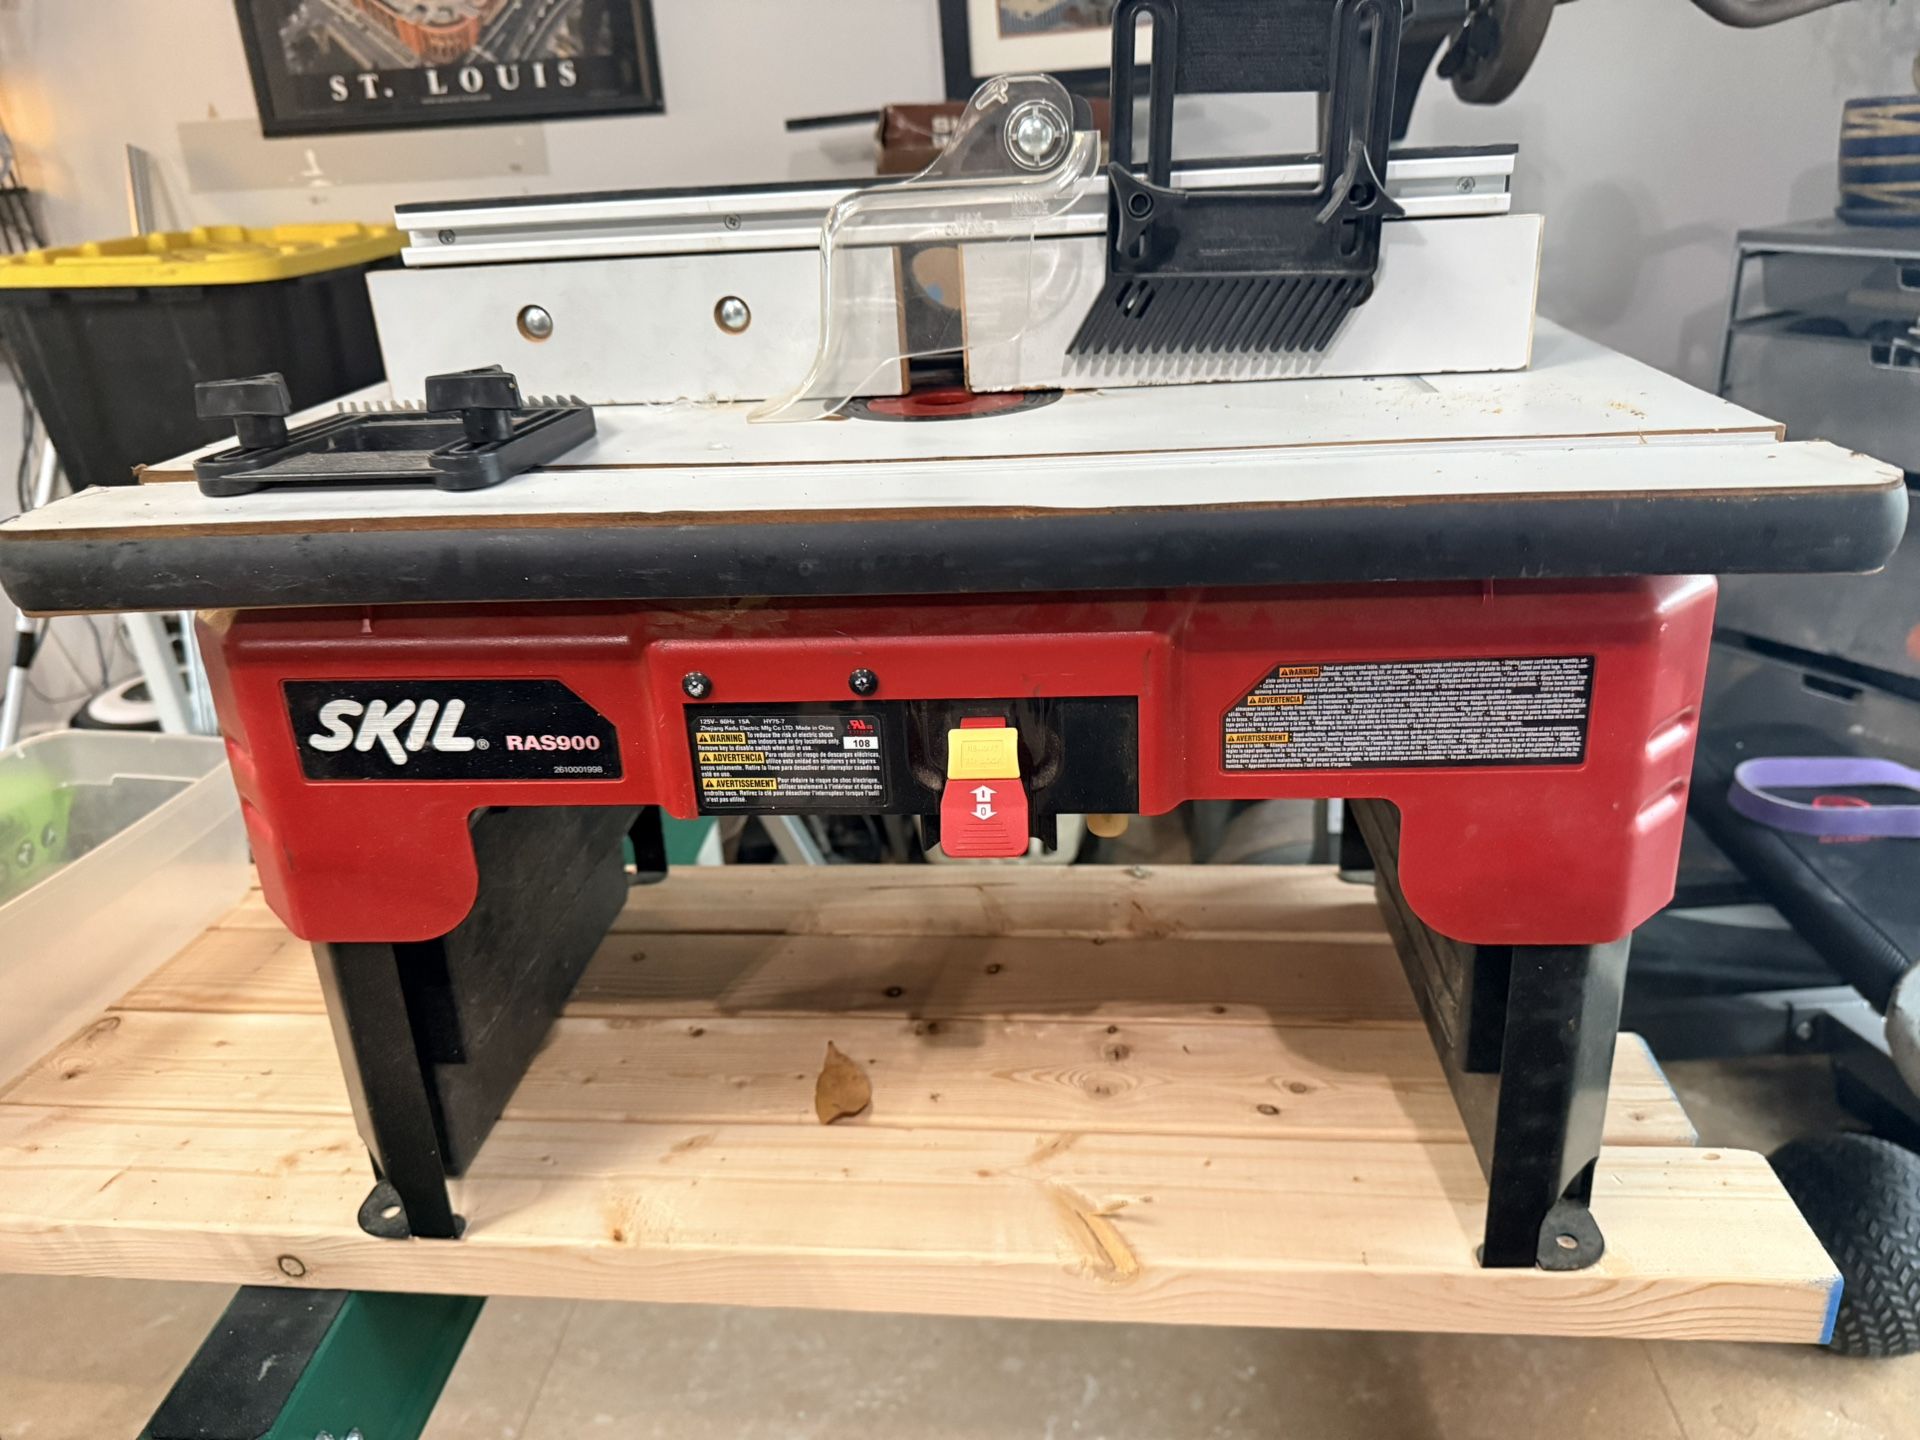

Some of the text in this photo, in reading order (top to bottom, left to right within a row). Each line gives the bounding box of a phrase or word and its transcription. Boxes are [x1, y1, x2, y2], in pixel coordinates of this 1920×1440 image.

[328, 61, 578, 103] ST. LOUIS
[1289, 668, 1318, 676] WARNING
[1257, 696, 1301, 704] ADVERTENCIA
[308, 698, 476, 766] SKIL
[708, 734, 743, 743] WARNING
[1236, 734, 1287, 742] AVERTISSEMENT
[506, 735, 601, 752] RAS900
[853, 739, 870, 748] 108
[713, 753, 763, 762] ADVERTENCIA
[553, 765, 604, 774] 2610001998
[716, 779, 774, 788] AVERTISSEMENT
